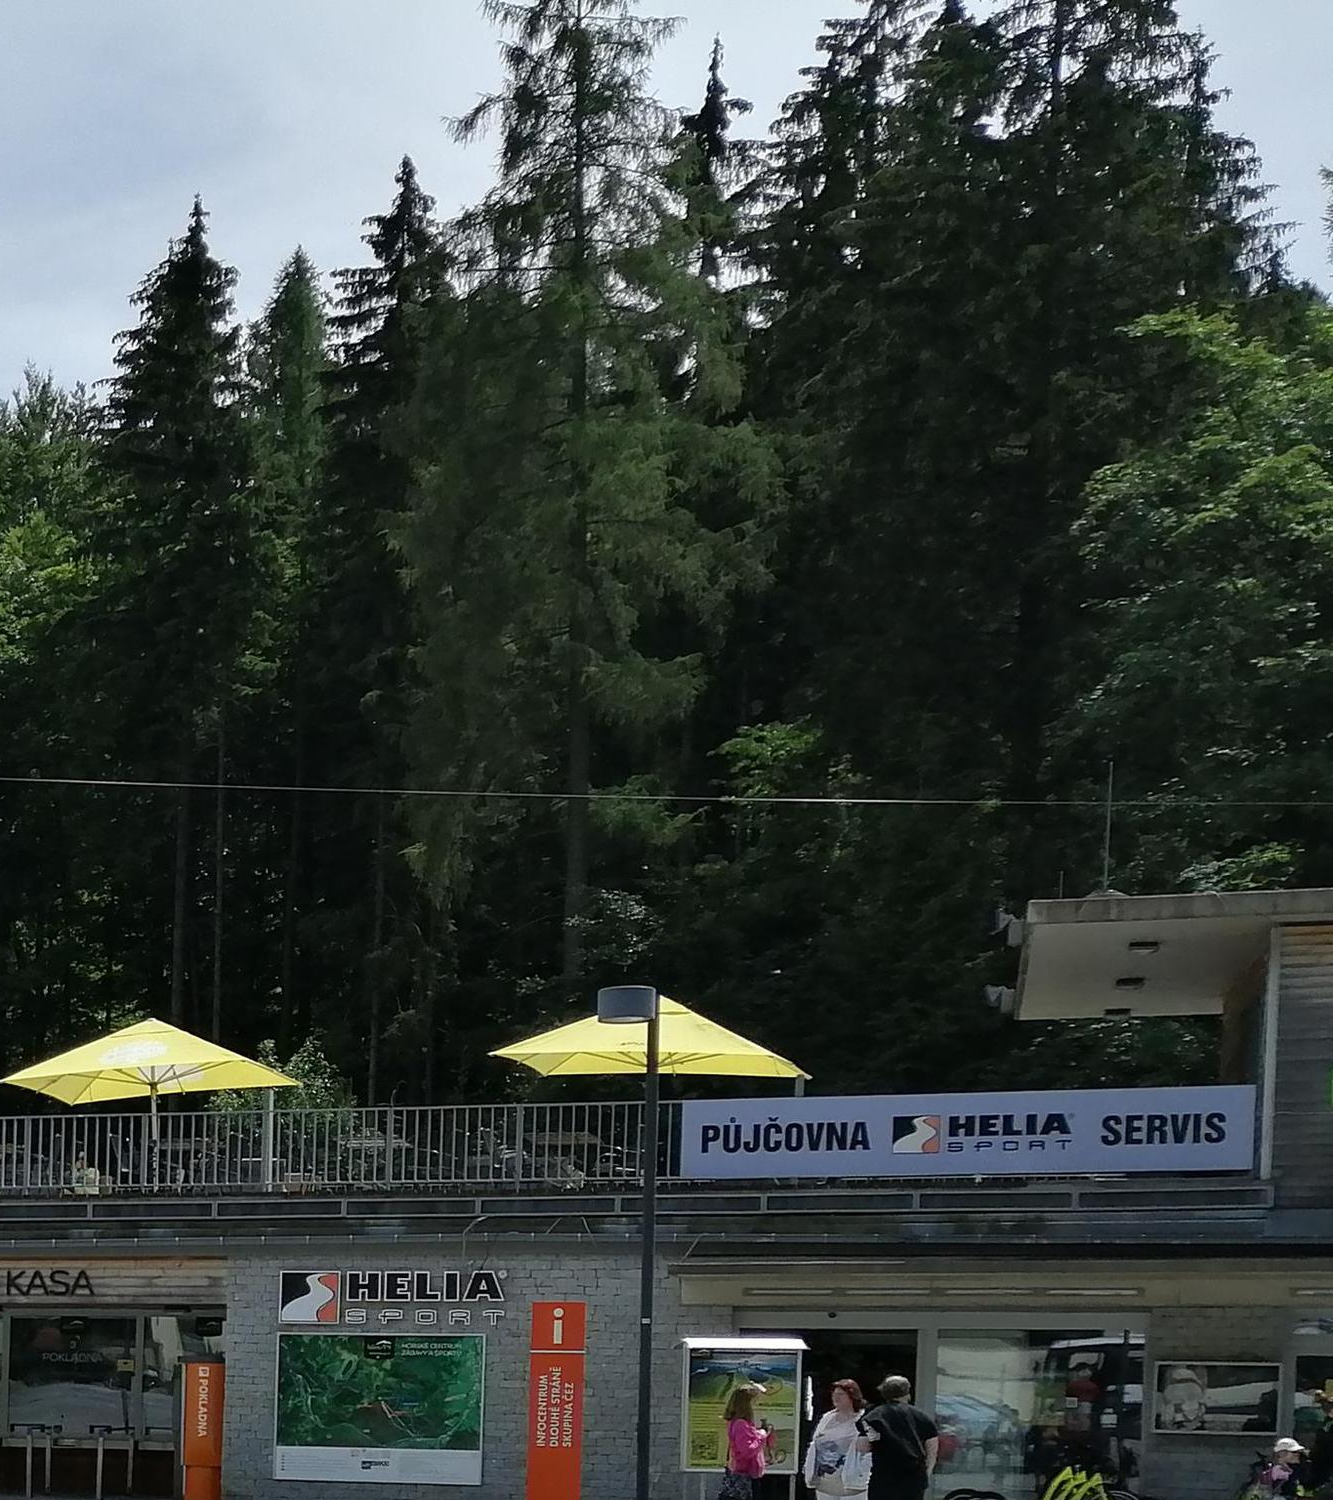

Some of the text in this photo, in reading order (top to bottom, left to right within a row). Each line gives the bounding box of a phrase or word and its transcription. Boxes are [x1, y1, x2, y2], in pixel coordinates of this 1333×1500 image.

[700, 1112, 1227, 1154] PŮJČOVNA HELIA SERVIS
[946, 1138, 1073, 1153] SPORT
[6, 1270, 96, 1297] KASA
[346, 1270, 505, 1302] HELIA
[344, 1308, 505, 1326] SPORT
[196, 1379, 210, 1437] POKLADNA
[535, 1374, 549, 1448] INFOCENTRUM
[548, 1365, 562, 1448] DLOUHÉ STRÁNĚ
[562, 1382, 575, 1449] SKUPINA ČEZ
